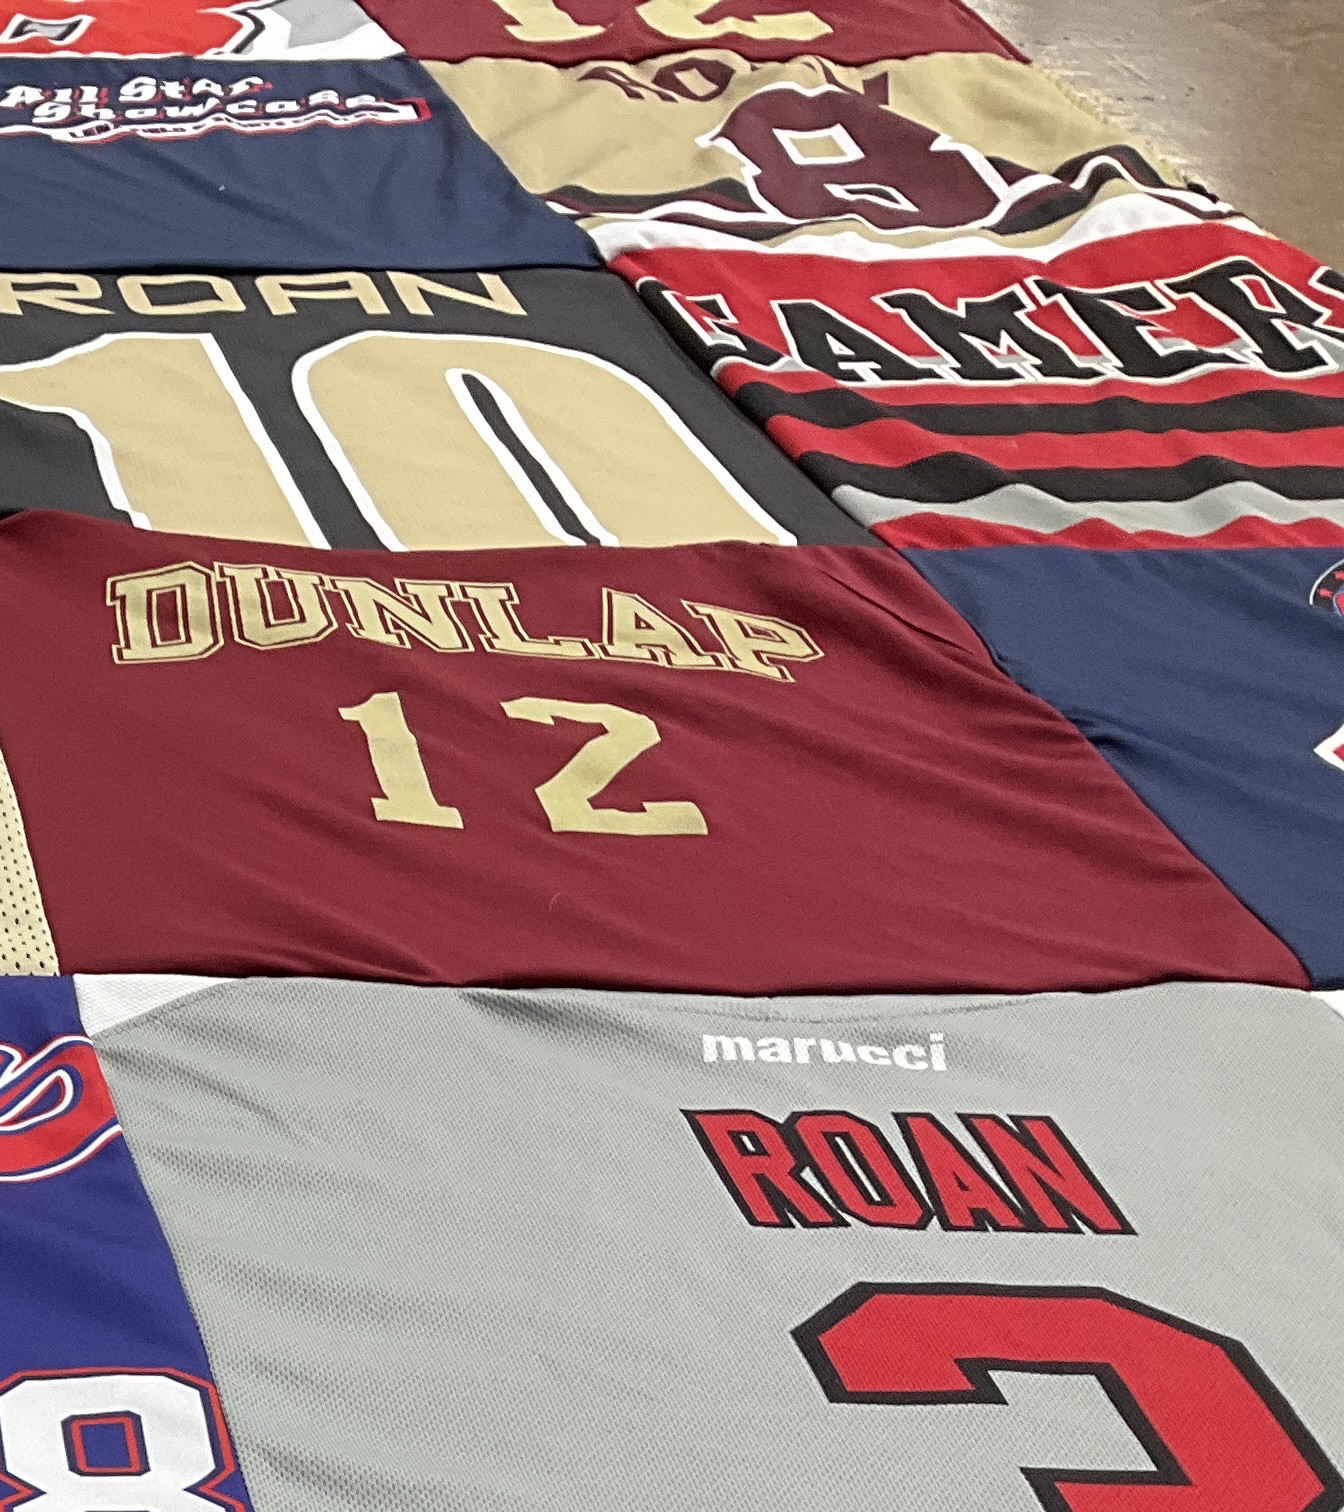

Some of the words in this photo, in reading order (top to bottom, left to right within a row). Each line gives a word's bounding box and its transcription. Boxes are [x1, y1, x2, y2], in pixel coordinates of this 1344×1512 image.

[118, 76, 273, 102] Star
[694, 80, 1011, 235] 8
[636, 256, 1344, 384] GAMER
[105, 562, 826, 684] DUNLAP
[338, 692, 709, 837] 12
[701, 1032, 949, 1072] marucci
[678, 1107, 1140, 1236] ROAN
